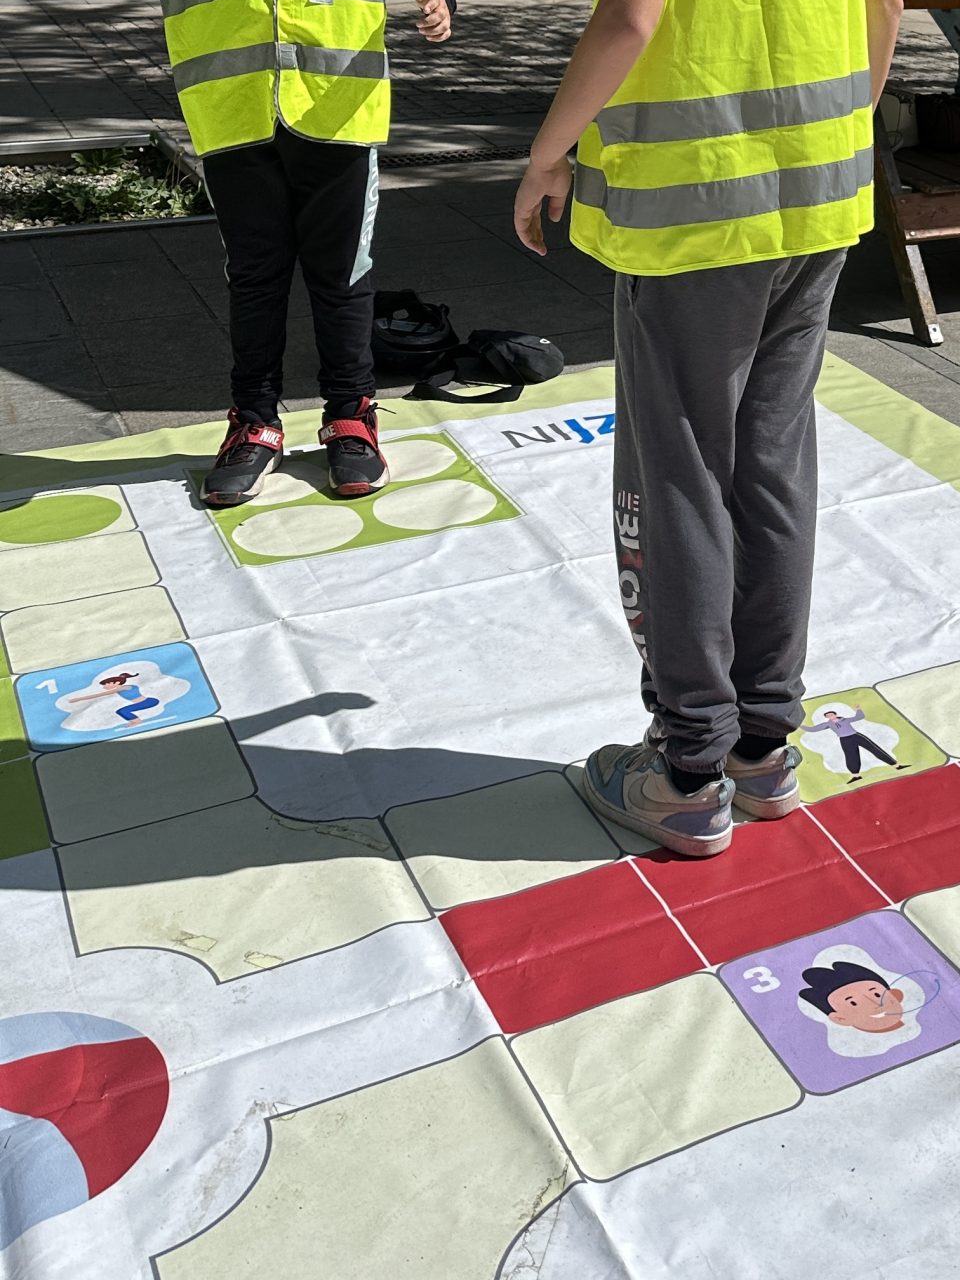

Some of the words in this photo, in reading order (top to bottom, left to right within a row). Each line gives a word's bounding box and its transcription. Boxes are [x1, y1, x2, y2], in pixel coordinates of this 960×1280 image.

[258, 429, 282, 447] NIKE
[320, 424, 337, 442] NIKE
[35, 678, 59, 695] 1
[742, 966, 782, 994] 3
